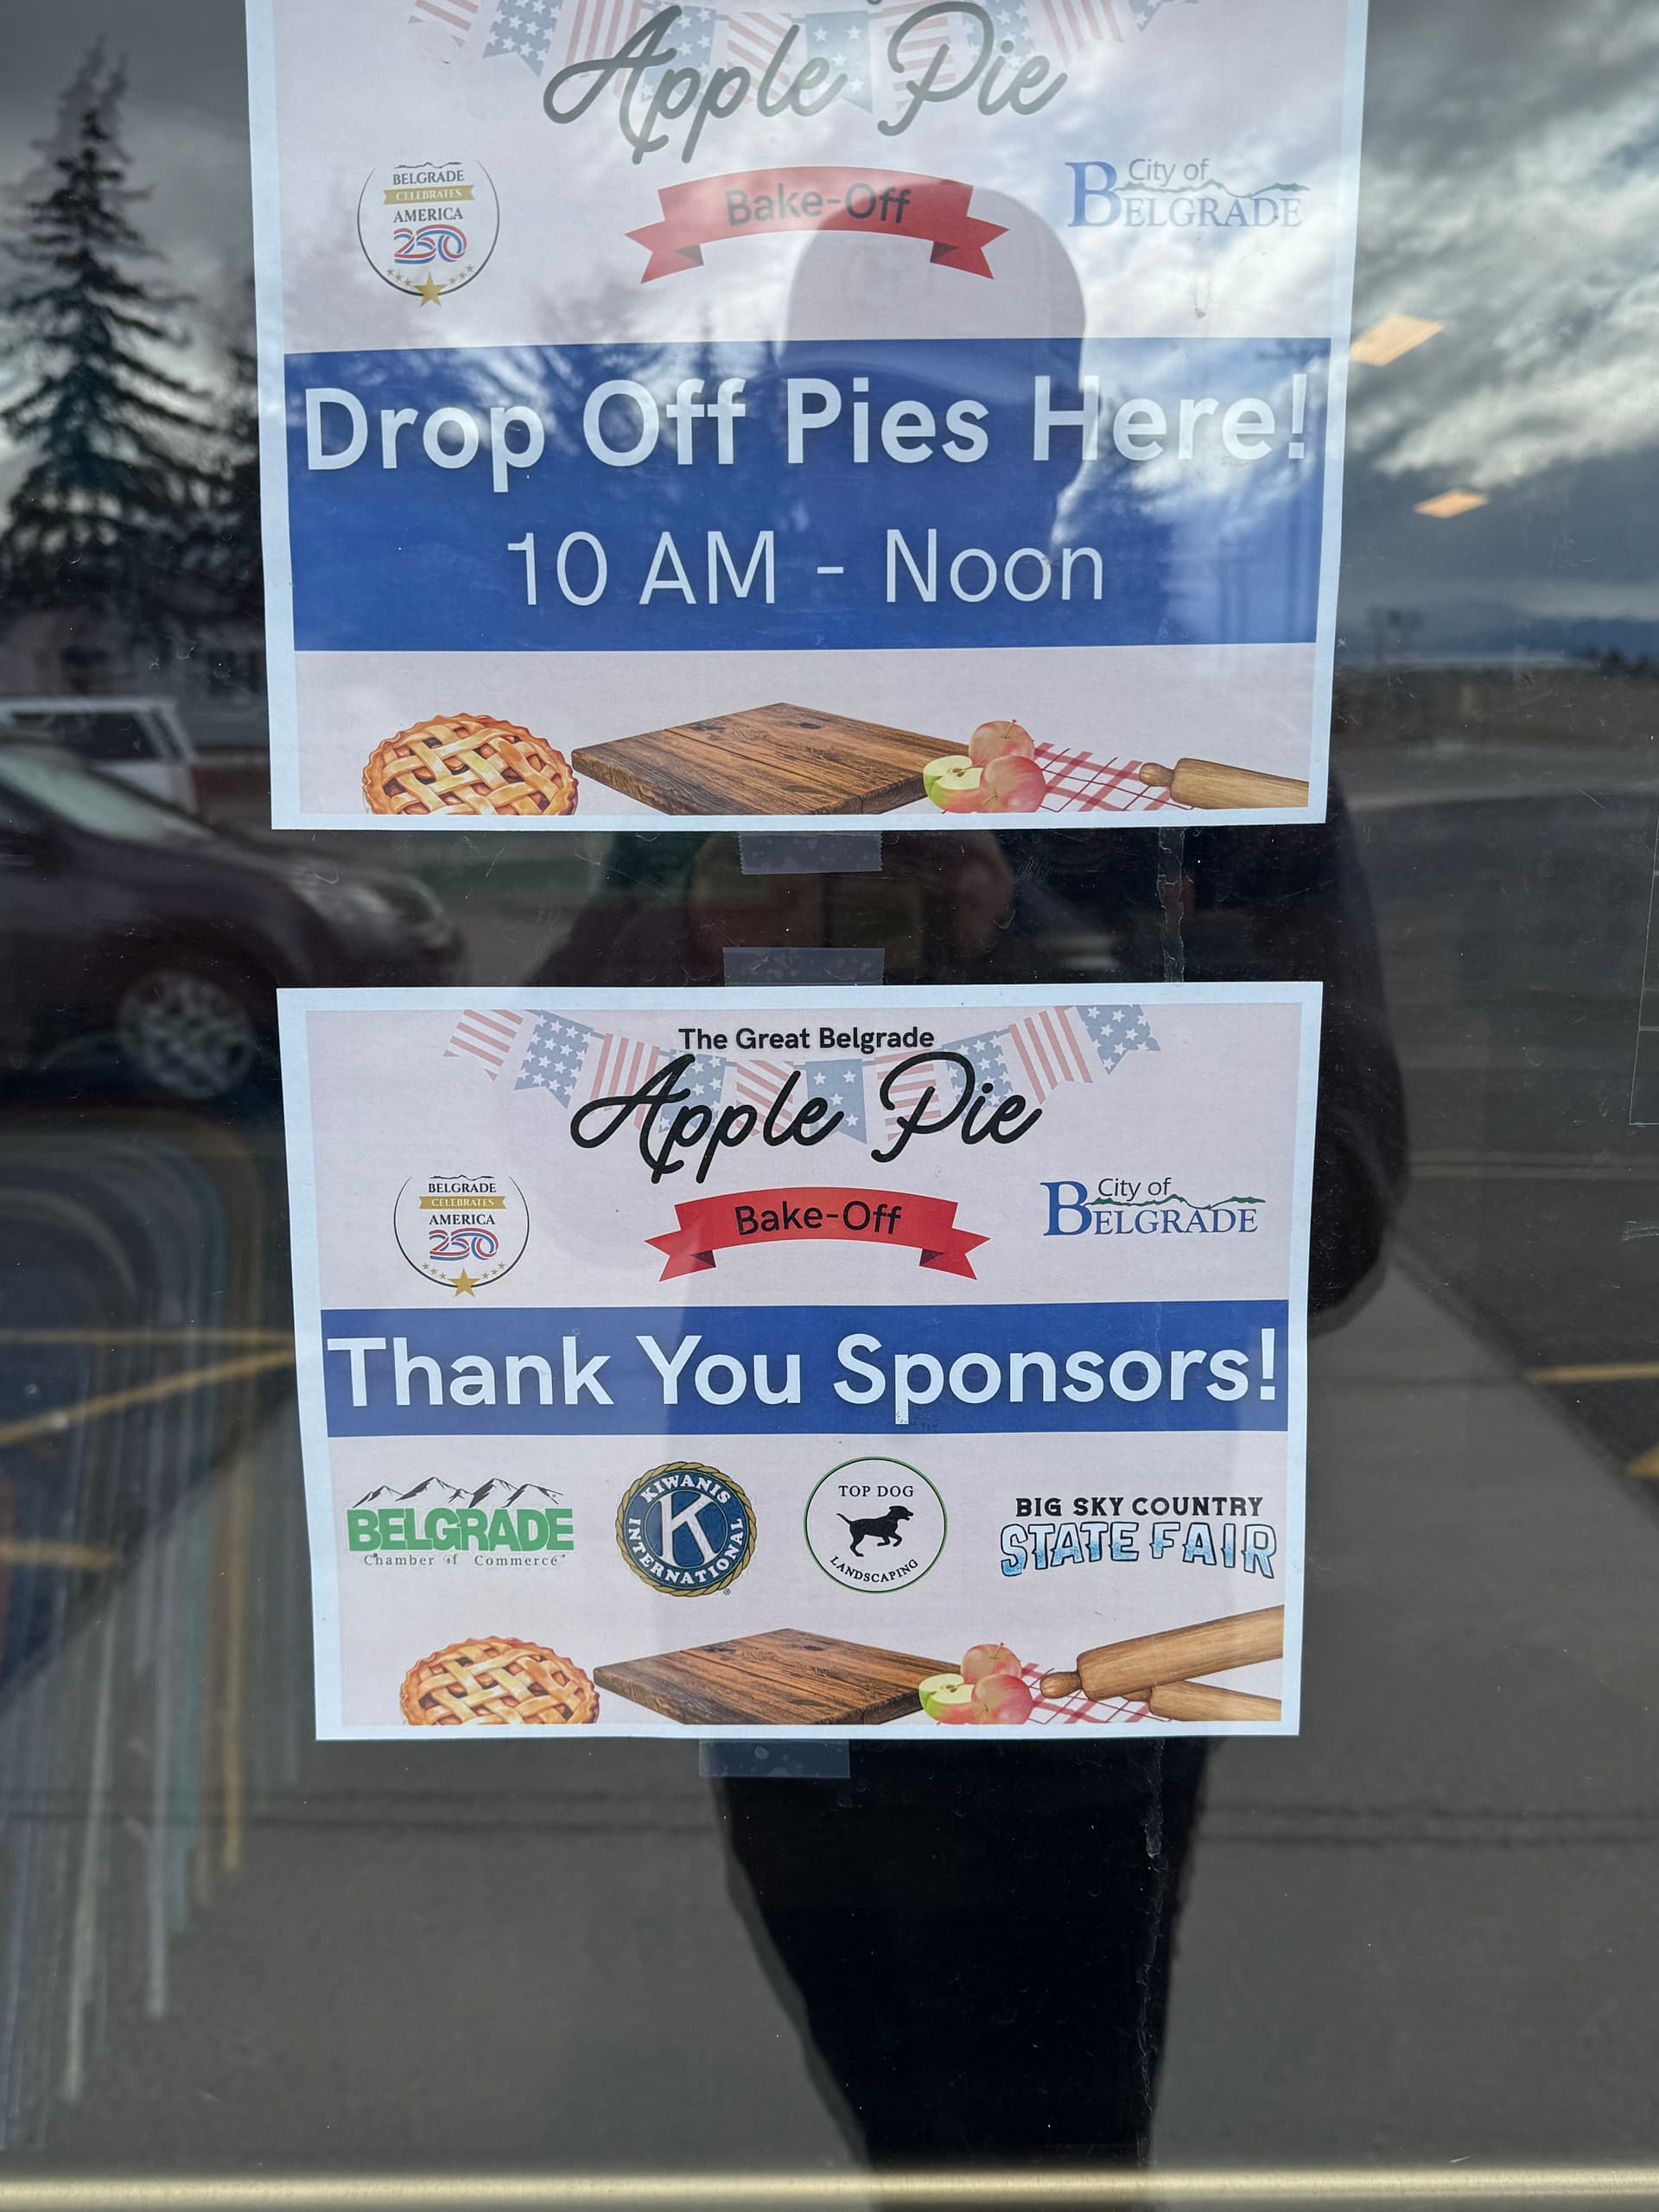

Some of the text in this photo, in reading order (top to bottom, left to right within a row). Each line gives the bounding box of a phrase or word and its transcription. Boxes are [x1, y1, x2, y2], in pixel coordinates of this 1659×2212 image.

[543, 1, 1068, 164] Apple Pie
[392, 168, 465, 185] BELGRADE
[1128, 158, 1210, 185] City of
[396, 188, 462, 200] CELEBRATES
[725, 182, 912, 226] Bake-Off
[1065, 161, 1302, 228] BELGRADE
[393, 207, 464, 223] AMERICA
[393, 225, 467, 264] 250
[305, 373, 1307, 493] Drop Off Pies Here!
[507, 528, 1104, 606] 10 AM - Noon
[678, 1027, 935, 1055] The Great Belgrade
[570, 1052, 1043, 1184] Apple Pie
[429, 1183, 497, 1193] BELGRADE
[431, 1198, 494, 1207] CELEBRATES
[1097, 1177, 1173, 1201] City of
[429, 1214, 496, 1225] AMERICA
[734, 1200, 902, 1236] Bake-Off
[1039, 1180, 1258, 1236] BELGRADE
[429, 1227, 499, 1262] 250
[327, 1328, 1276, 1425] Thank You Sponsors!
[640, 1475, 731, 1504] KIWANIS
[838, 1484, 914, 1497] TOP DOG
[1016, 1497, 1263, 1517] BIG SKY COUNTRY
[346, 1508, 575, 1552] BELGRADE
[658, 1491, 719, 1568] K
[364, 1554, 435, 1566] Chamber
[474, 1554, 558, 1566] Commerce
[628, 1517, 744, 1585] INTERNATIONAL
[1001, 1522, 1277, 1580] STATE FAIR
[830, 1555, 919, 1583] LANDSCAPING
